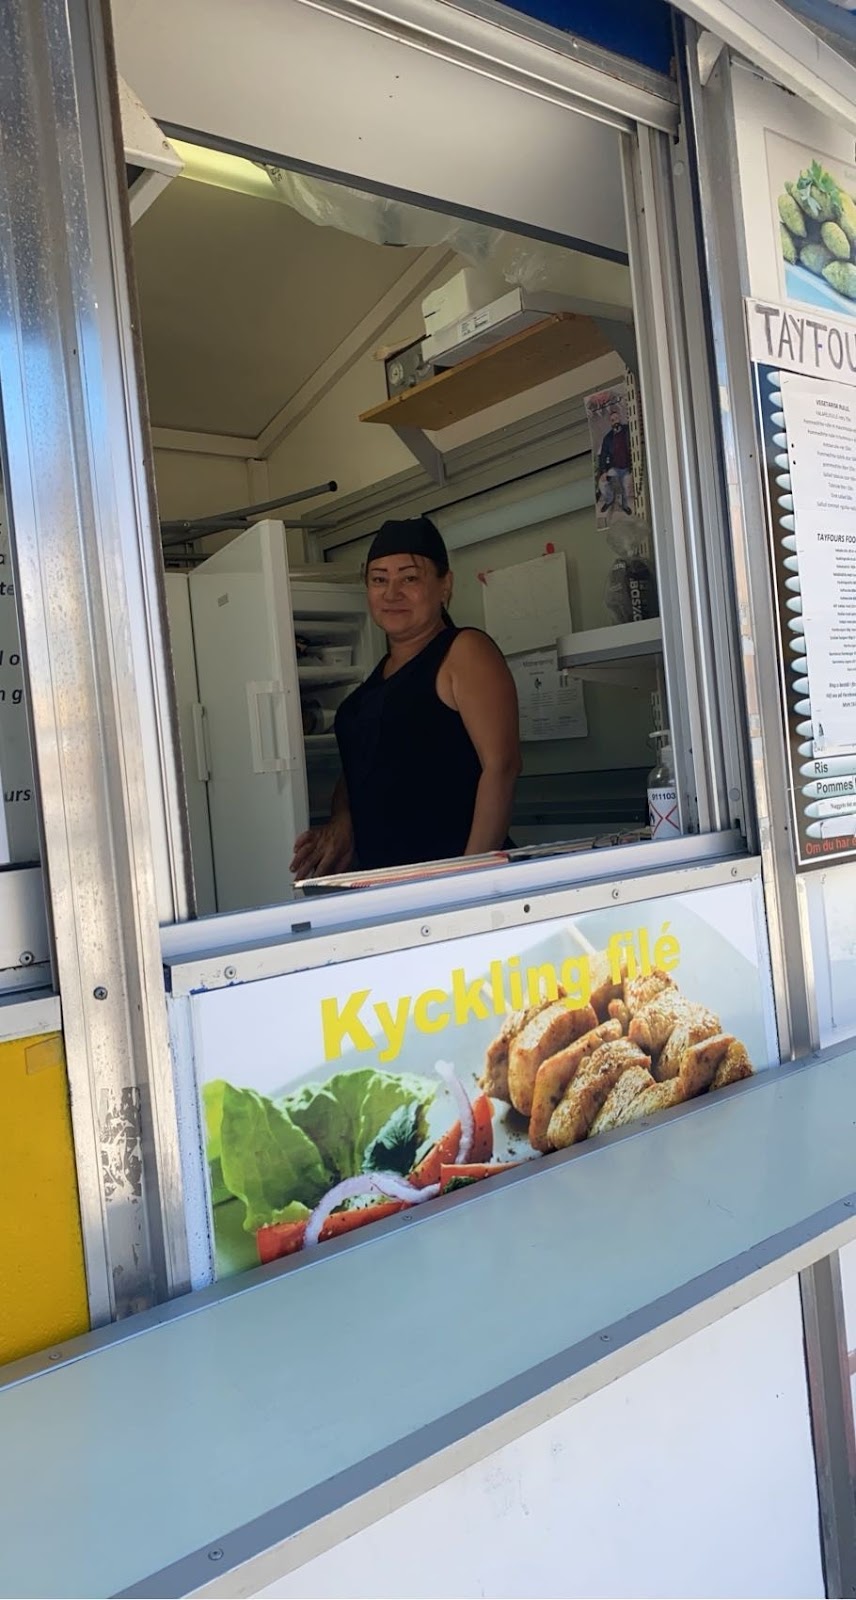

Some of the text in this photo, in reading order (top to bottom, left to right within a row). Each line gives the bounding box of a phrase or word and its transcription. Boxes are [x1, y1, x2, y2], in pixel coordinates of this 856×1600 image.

[817, 533, 845, 543] TAYFOURS
[814, 761, 828, 774] Ris
[816, 780, 853, 794] Pommes
[806, 842, 820, 855] Om
[823, 840, 834, 851] du
[836, 838, 849, 849] har
[320, 922, 680, 1063] Kyckling filé
